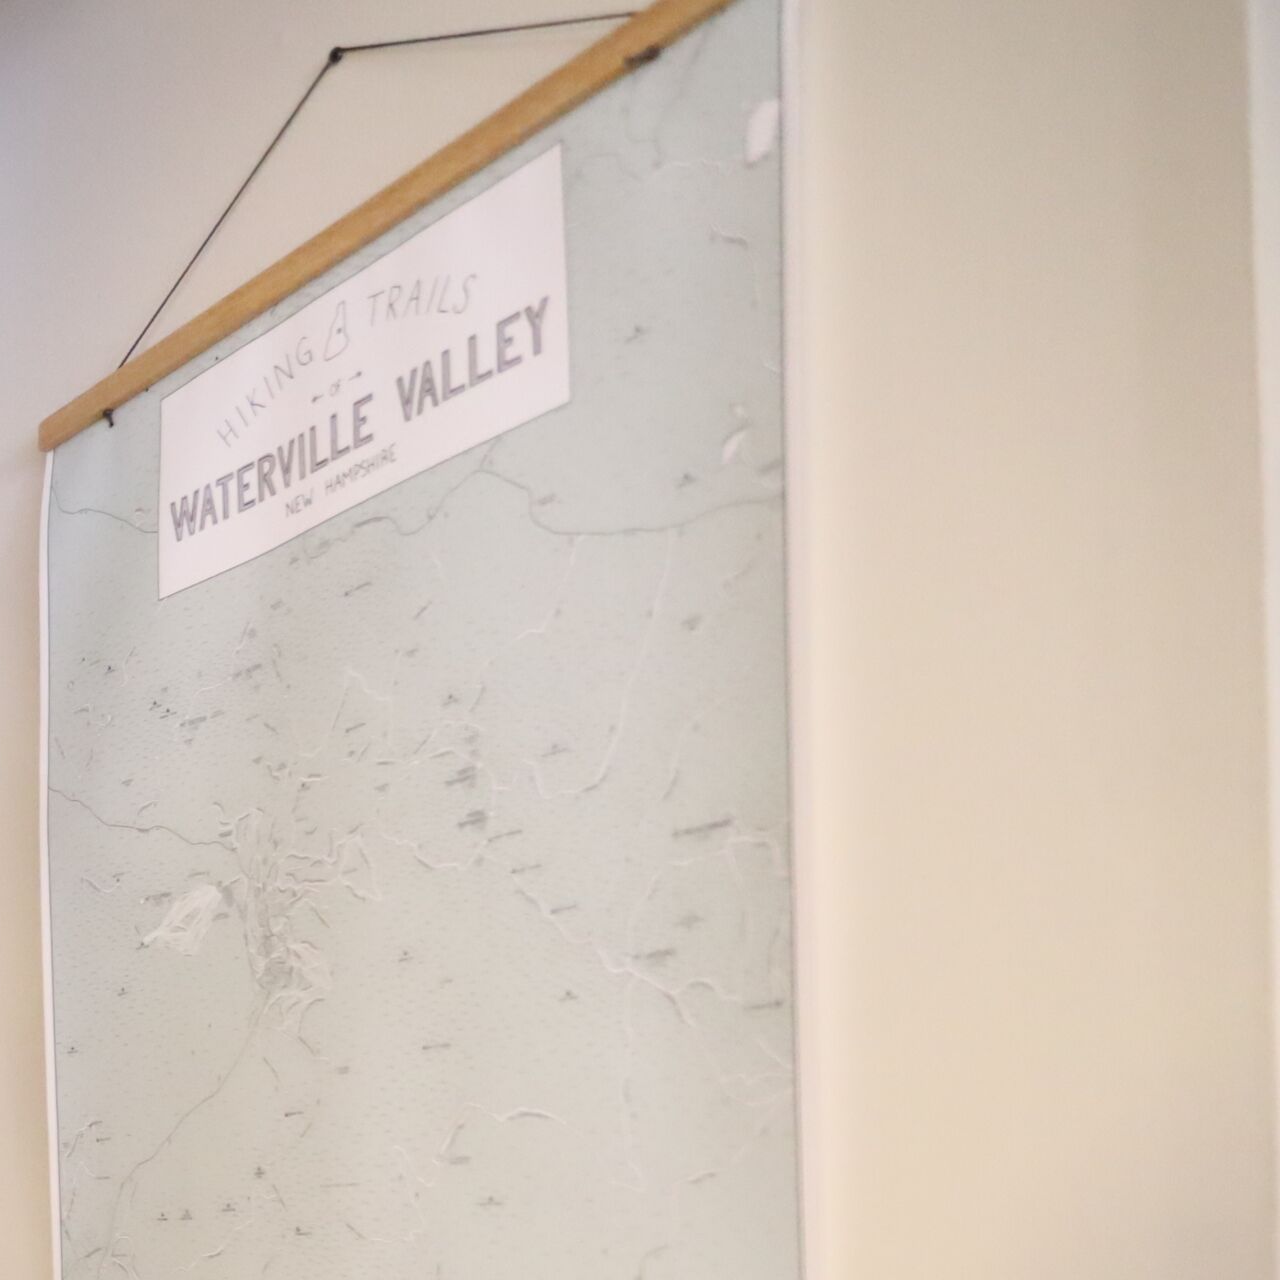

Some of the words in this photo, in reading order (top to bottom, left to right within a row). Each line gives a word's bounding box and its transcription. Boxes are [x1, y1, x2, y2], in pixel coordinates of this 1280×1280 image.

[170, 393, 375, 543] WATERVILLE
[395, 295, 552, 423] VALLEY
[216, 336, 314, 448] HIKING
[367, 273, 478, 328] TRAILS
[285, 490, 315, 518] NEW
[324, 442, 399, 495] HAMPSHIRE
